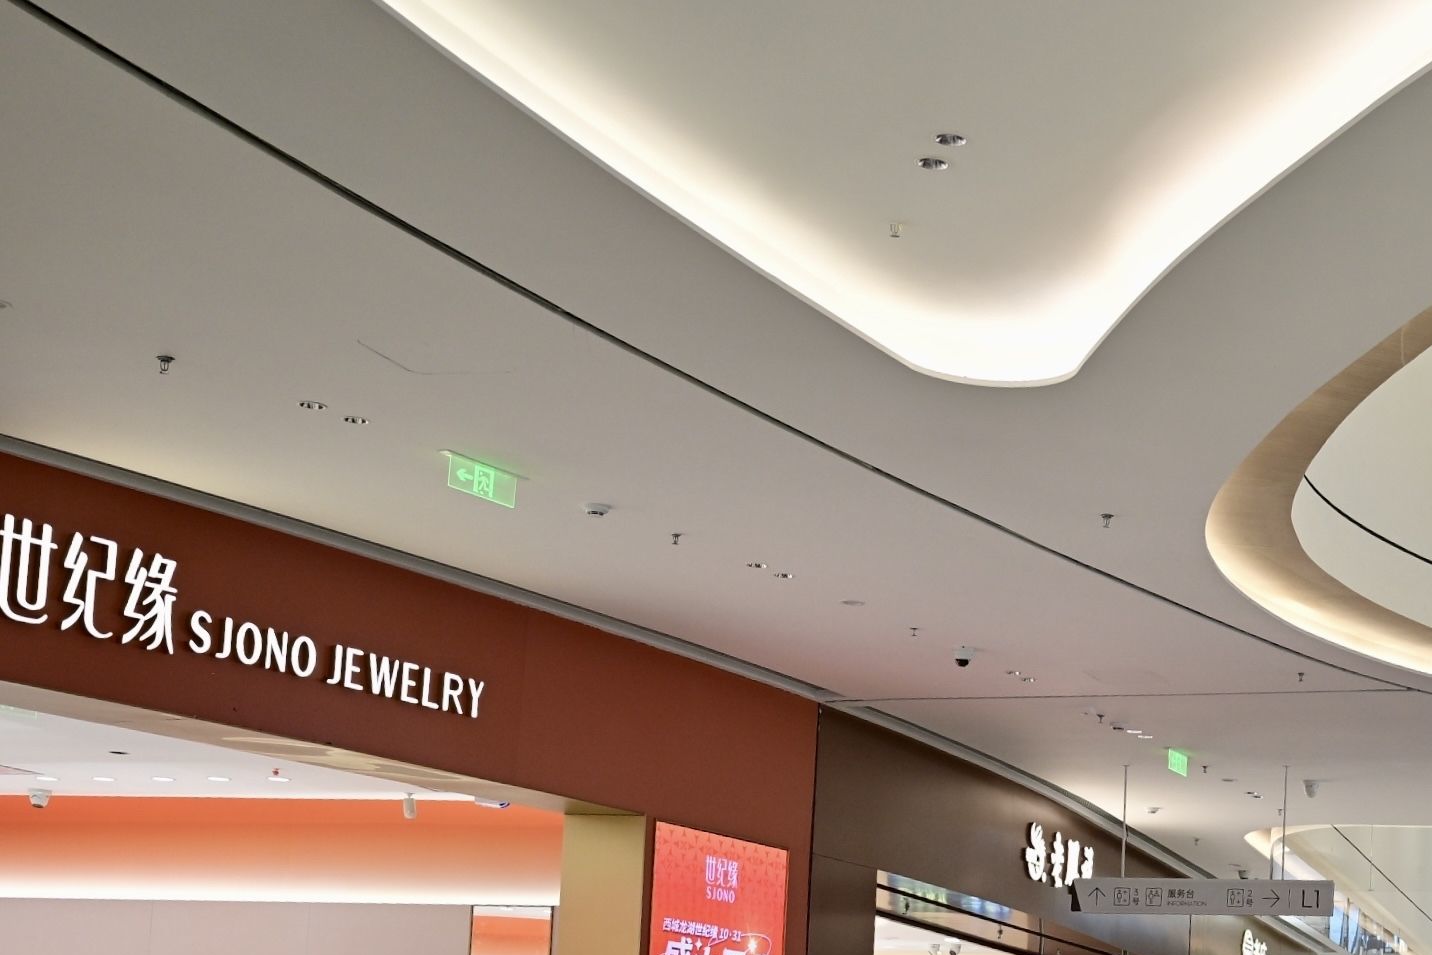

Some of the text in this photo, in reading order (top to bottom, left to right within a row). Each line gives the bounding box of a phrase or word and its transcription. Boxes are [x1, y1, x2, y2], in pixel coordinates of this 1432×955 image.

[0, 513, 485, 719] 世纪缘 SJONO JEWELRY
[705, 855, 739, 888] 世纪缘
[706, 886, 736, 904] SJONO
[1167, 888, 1195, 899] 服务台
[1301, 889, 1320, 909] L1
[662, 917, 719, 943] 西城龙湖世纪缘
